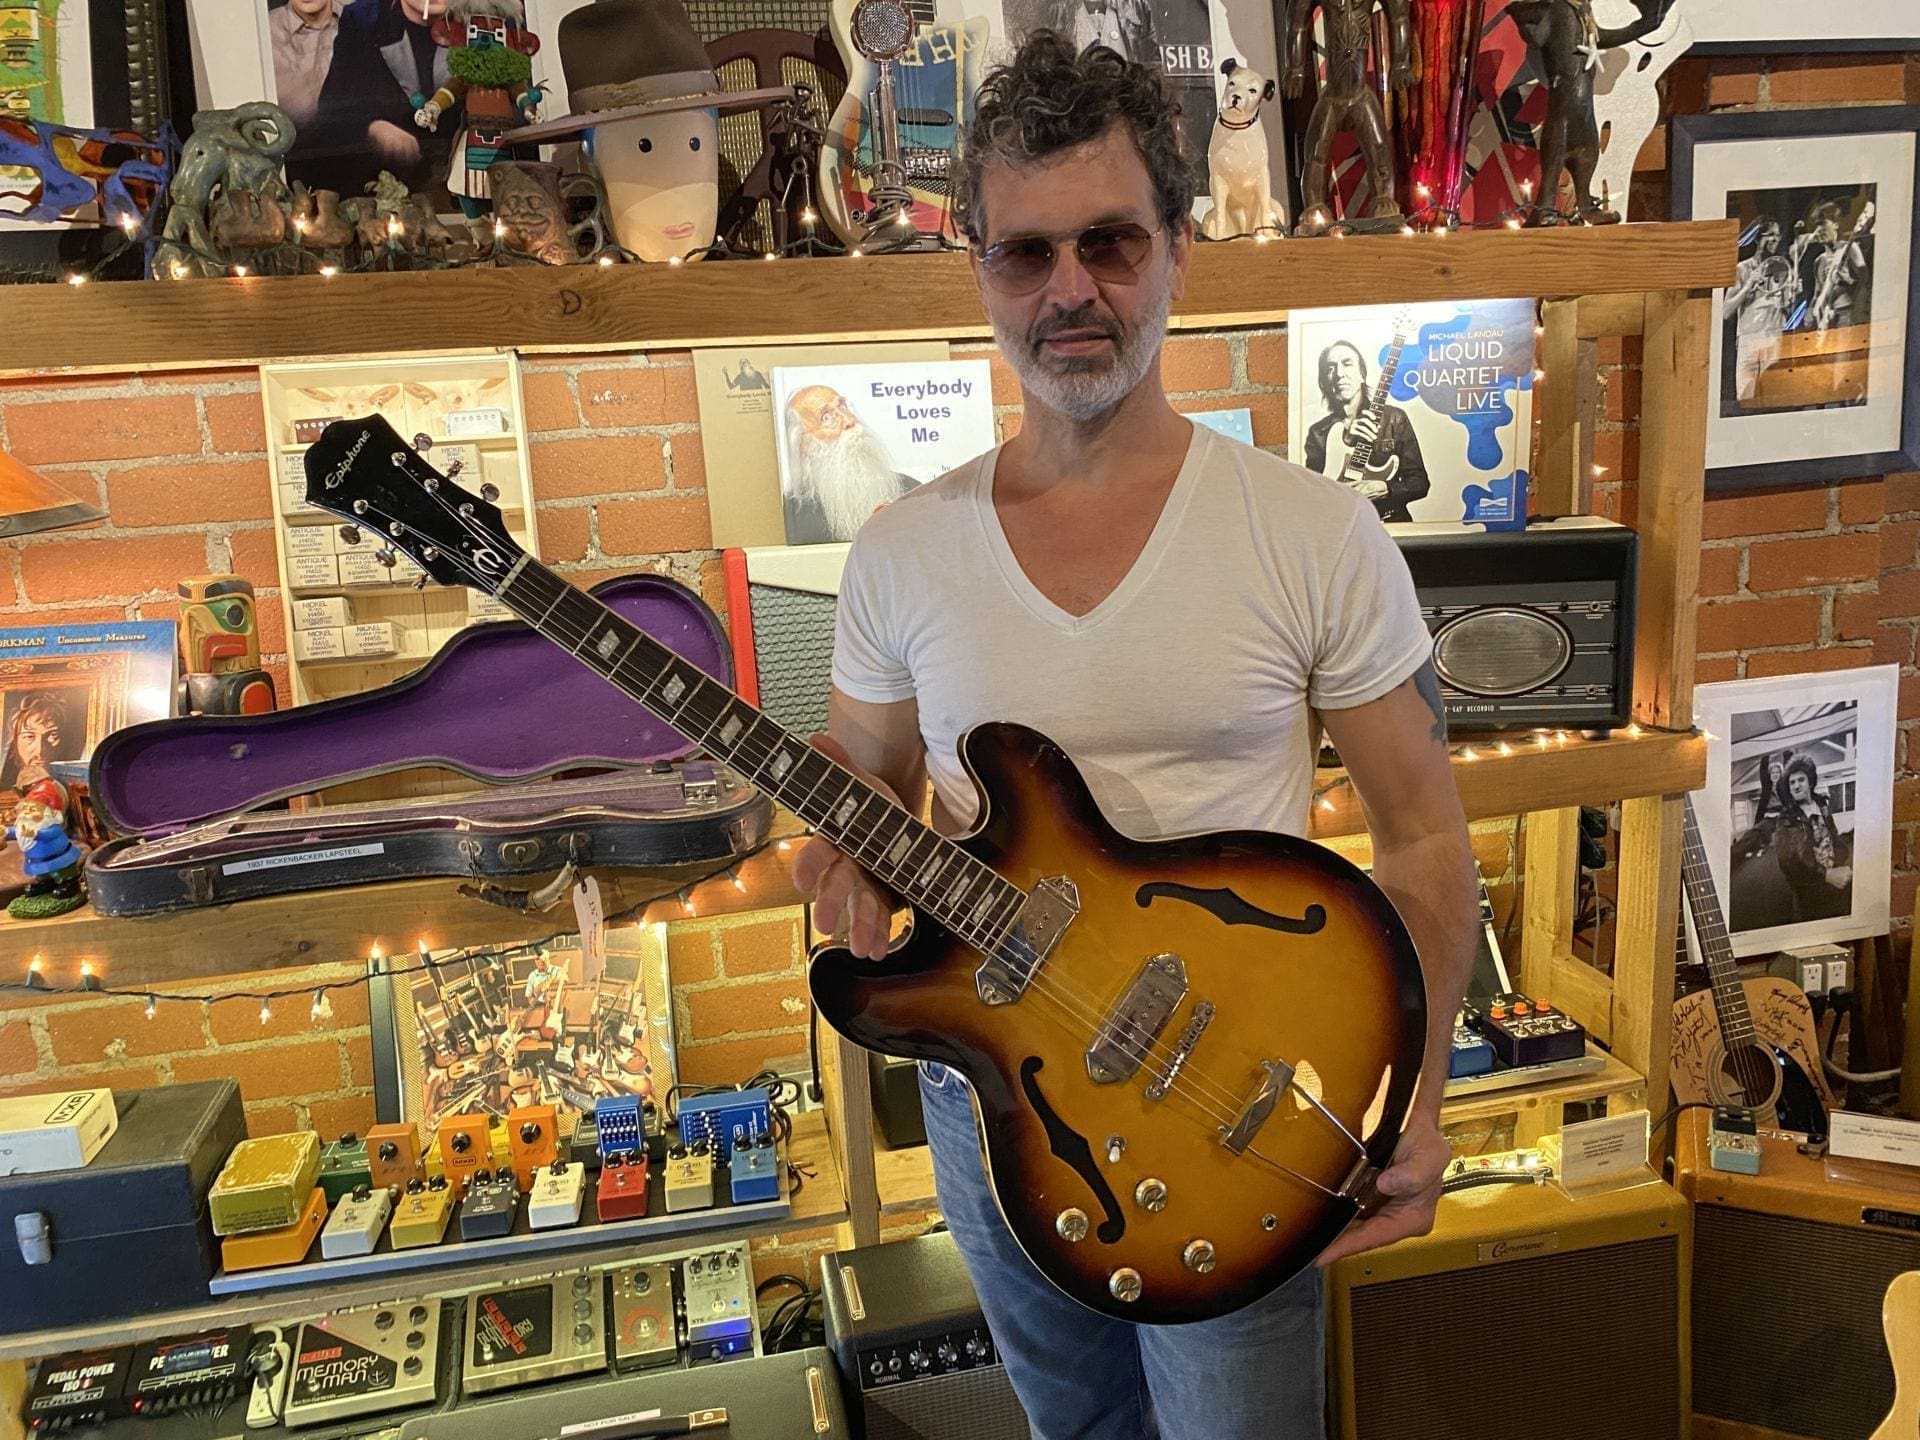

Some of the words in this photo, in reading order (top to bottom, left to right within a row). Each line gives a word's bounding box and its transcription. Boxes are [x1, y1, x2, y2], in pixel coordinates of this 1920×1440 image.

[1428, 332, 1466, 340] MICHAEL
[1467, 330, 1504, 339] LANDAU
[1428, 341, 1503, 364] LIQUID
[1403, 366, 1503, 391] QUARTET
[871, 378, 973, 400] Everybody
[1456, 391, 1501, 410] LIVE
[896, 404, 951, 420] Loves
[911, 427, 940, 443] Me
[325, 430, 371, 490] Epiphone
[290, 526, 322, 534] ANTIQUE
[296, 556, 328, 565] ANTIQUE
[302, 600, 328, 608] NICKEL
[356, 624, 382, 632] NICKEL
[57, 635, 101, 645] Uncommon
[105, 633, 146, 642] Measures
[1467, 705, 1495, 713] RECORDIO
[247, 859, 264, 869] 1937
[265, 852, 324, 865] RICKENBACKER
[325, 847, 362, 859] LAPSTEEL
[52, 1095, 87, 1121] MXR
[454, 1157, 475, 1166] MXR
[46, 1369, 78, 1385] PEDAL
[79, 1362, 115, 1379] POWER
[296, 1354, 379, 1382] MEMORY
[62, 1379, 80, 1393] ISO
[322, 1369, 367, 1389] MAN
[874, 1373, 901, 1384] NORMAL
[617, 1414, 637, 1423] SALE
